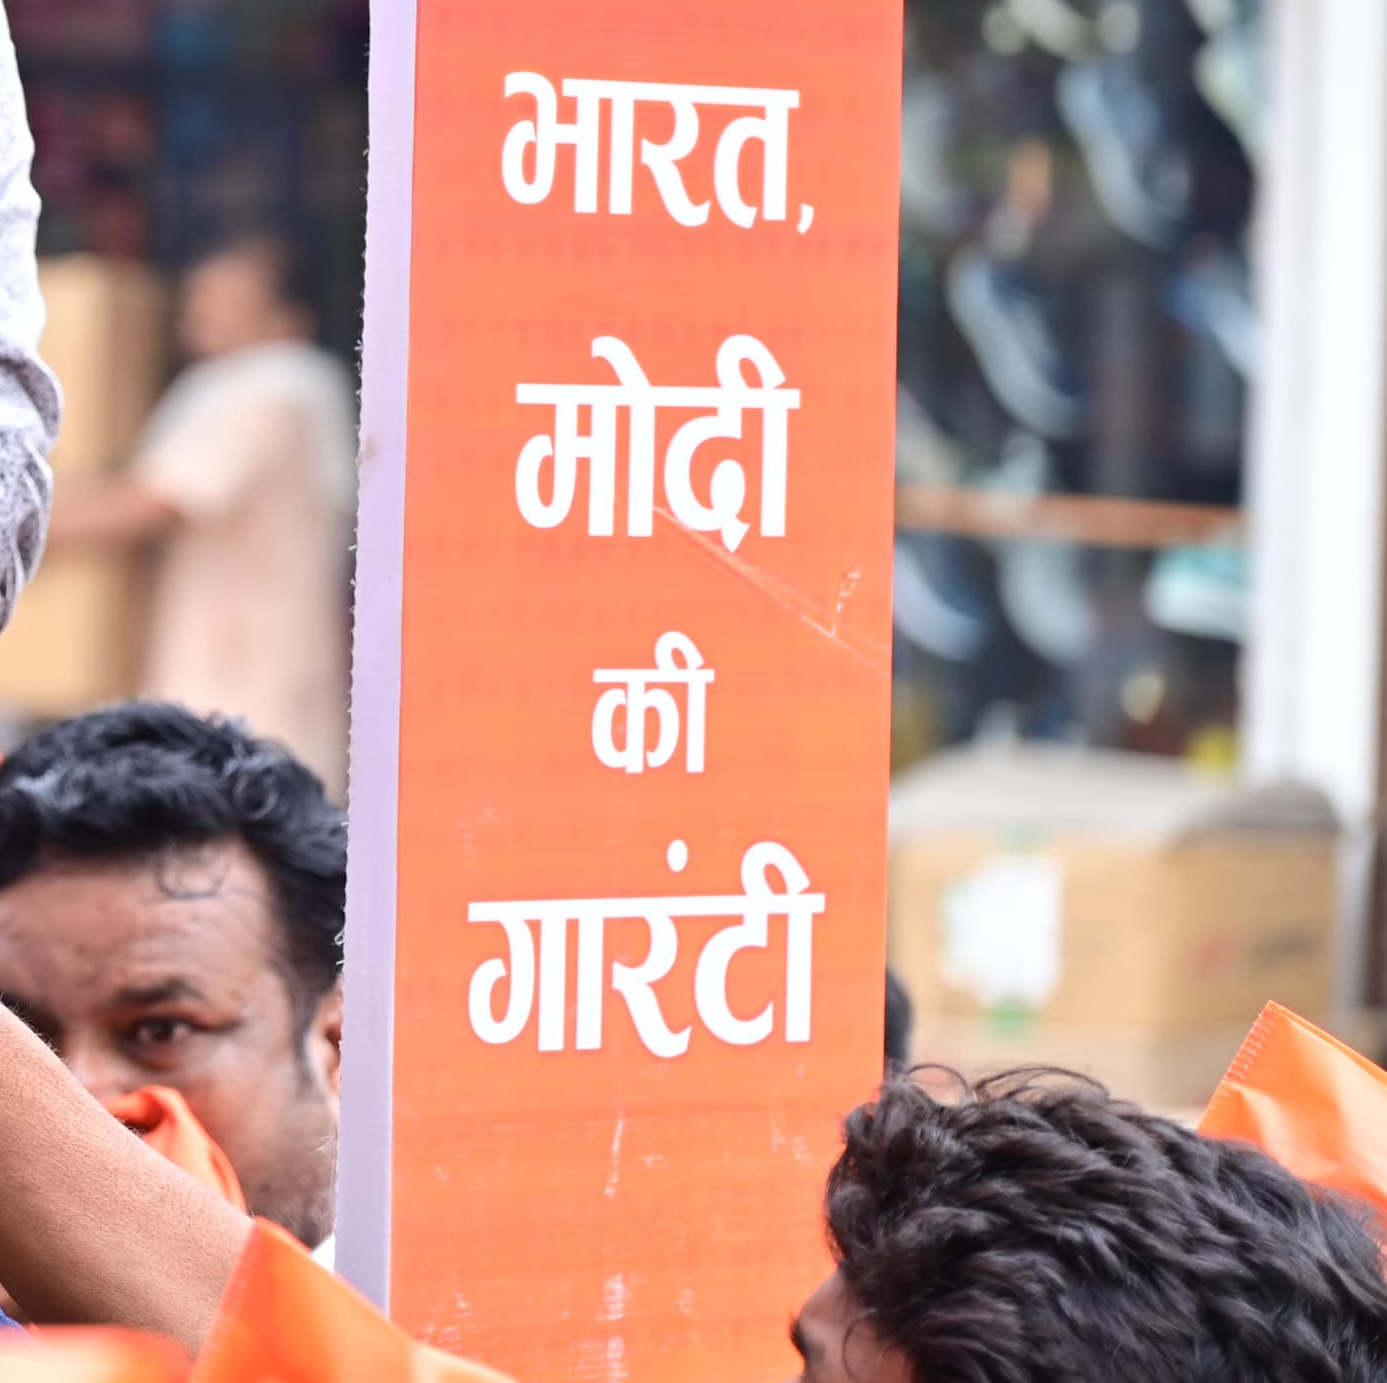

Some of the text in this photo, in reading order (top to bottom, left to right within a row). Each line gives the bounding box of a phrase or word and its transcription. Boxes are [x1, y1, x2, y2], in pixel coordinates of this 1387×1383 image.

[501, 71, 815, 235] भारत,
[514, 334, 801, 553] मोदी
[591, 631, 716, 774] की
[467, 839, 826, 1059] गारंटी
